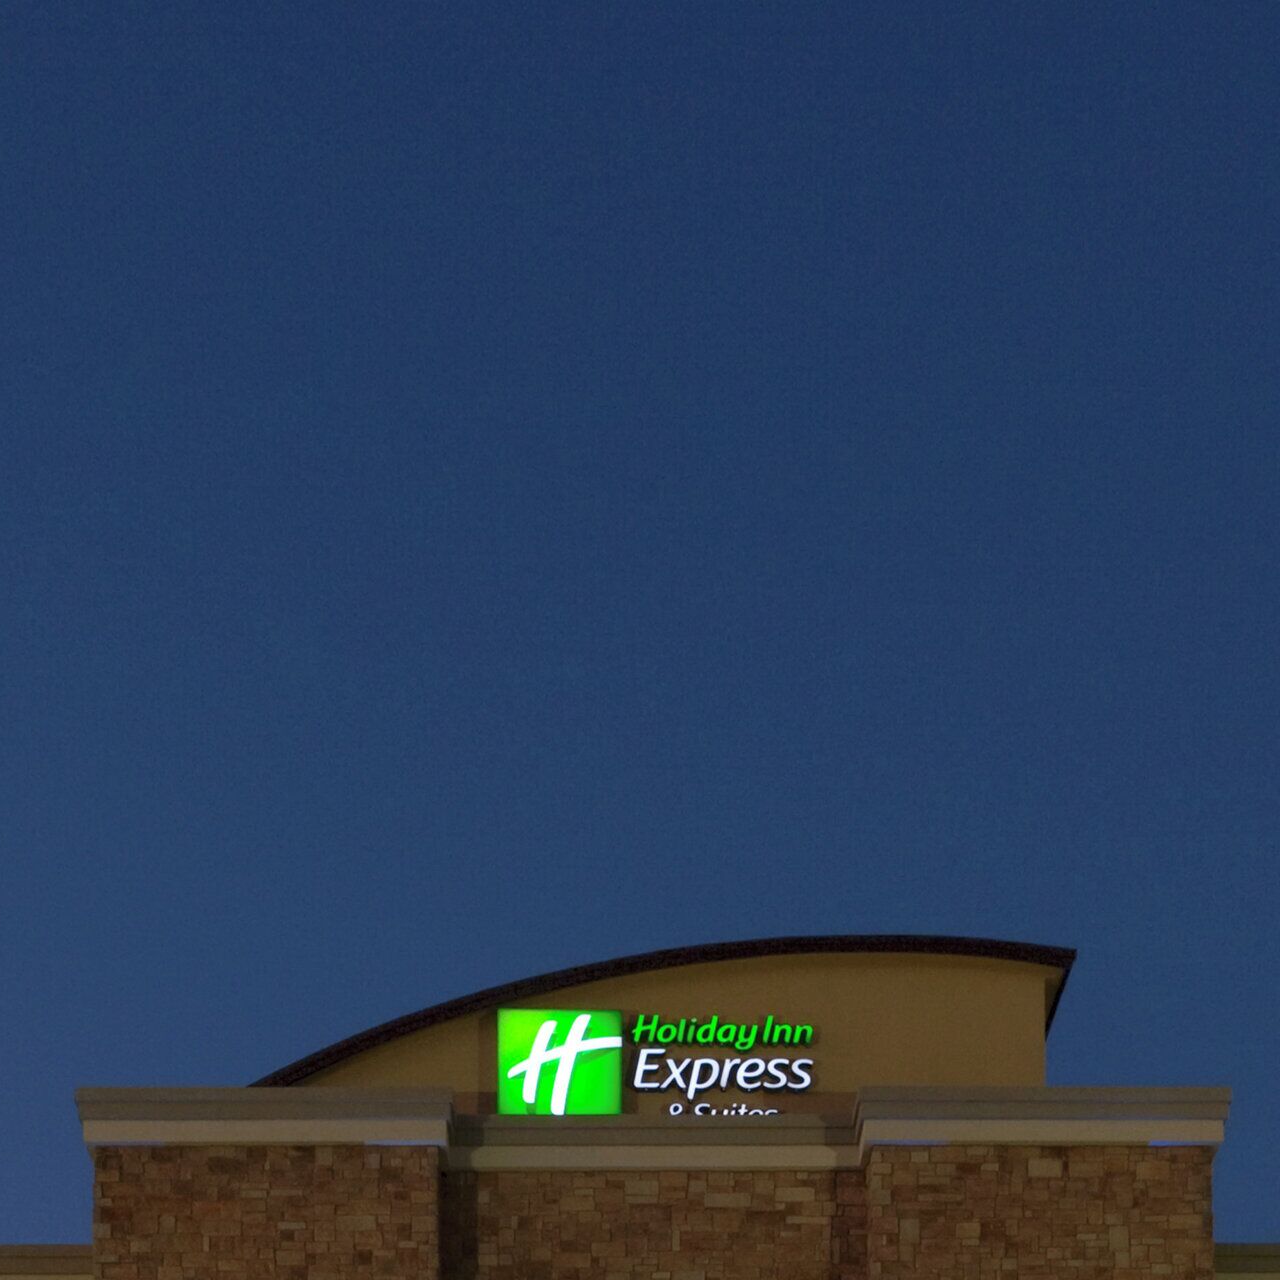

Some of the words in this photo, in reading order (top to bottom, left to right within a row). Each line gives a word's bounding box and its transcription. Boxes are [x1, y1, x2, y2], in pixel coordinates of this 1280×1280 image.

[632, 1014, 758, 1050] Holiday
[762, 1014, 814, 1045] Inn
[632, 1048, 814, 1100] Express
